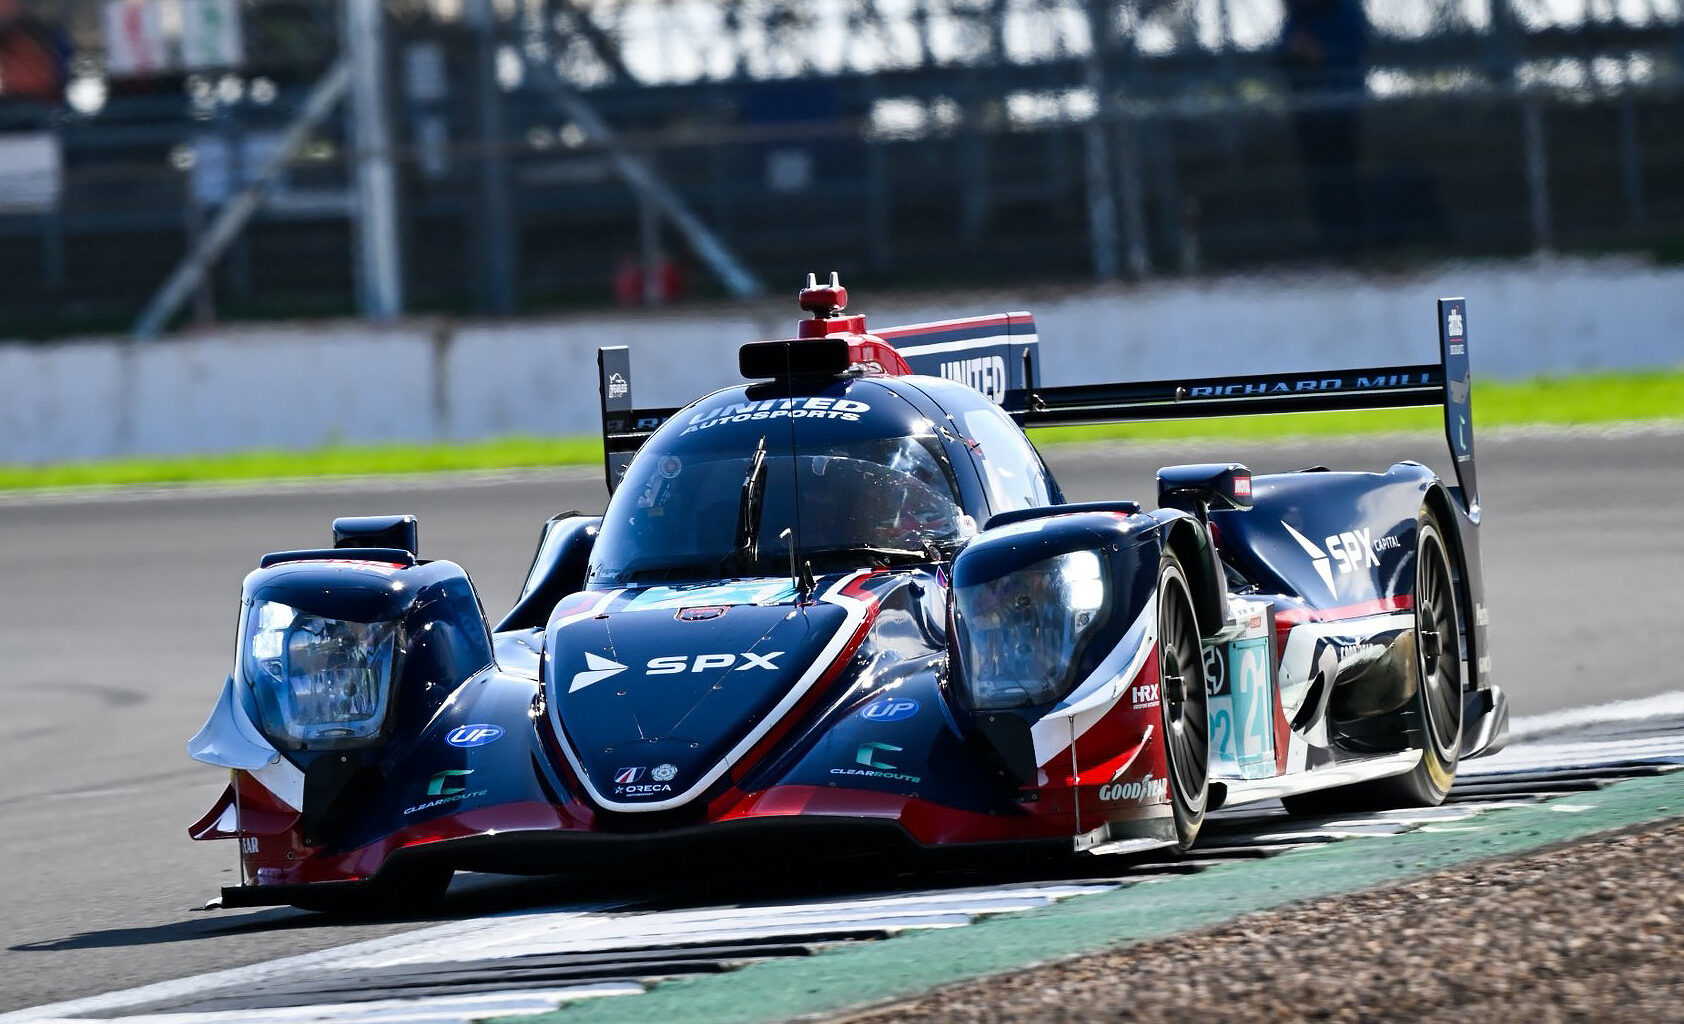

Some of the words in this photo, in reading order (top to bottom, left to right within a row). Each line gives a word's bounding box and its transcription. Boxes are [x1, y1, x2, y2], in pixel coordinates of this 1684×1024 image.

[1191, 378, 1342, 396] RICHARD
[1357, 373, 1430, 388] MILL
[688, 396, 871, 424] UNITED
[679, 409, 861, 437] AUTOSPORTS
[1325, 527, 1380, 574] SPX
[1374, 535, 1401, 552] CAPITAL
[645, 651, 786, 675] SPX
[1132, 683, 1159, 704] HRX
[1239, 648, 1270, 755] 21
[866, 702, 915, 717] UP
[450, 729, 499, 742] UP
[830, 768, 921, 783] CLEARROUTE
[625, 784, 672, 793] ORECA
[1099, 774, 1168, 804] GOODYEAR
[403, 789, 488, 815] CLEARROUTE
